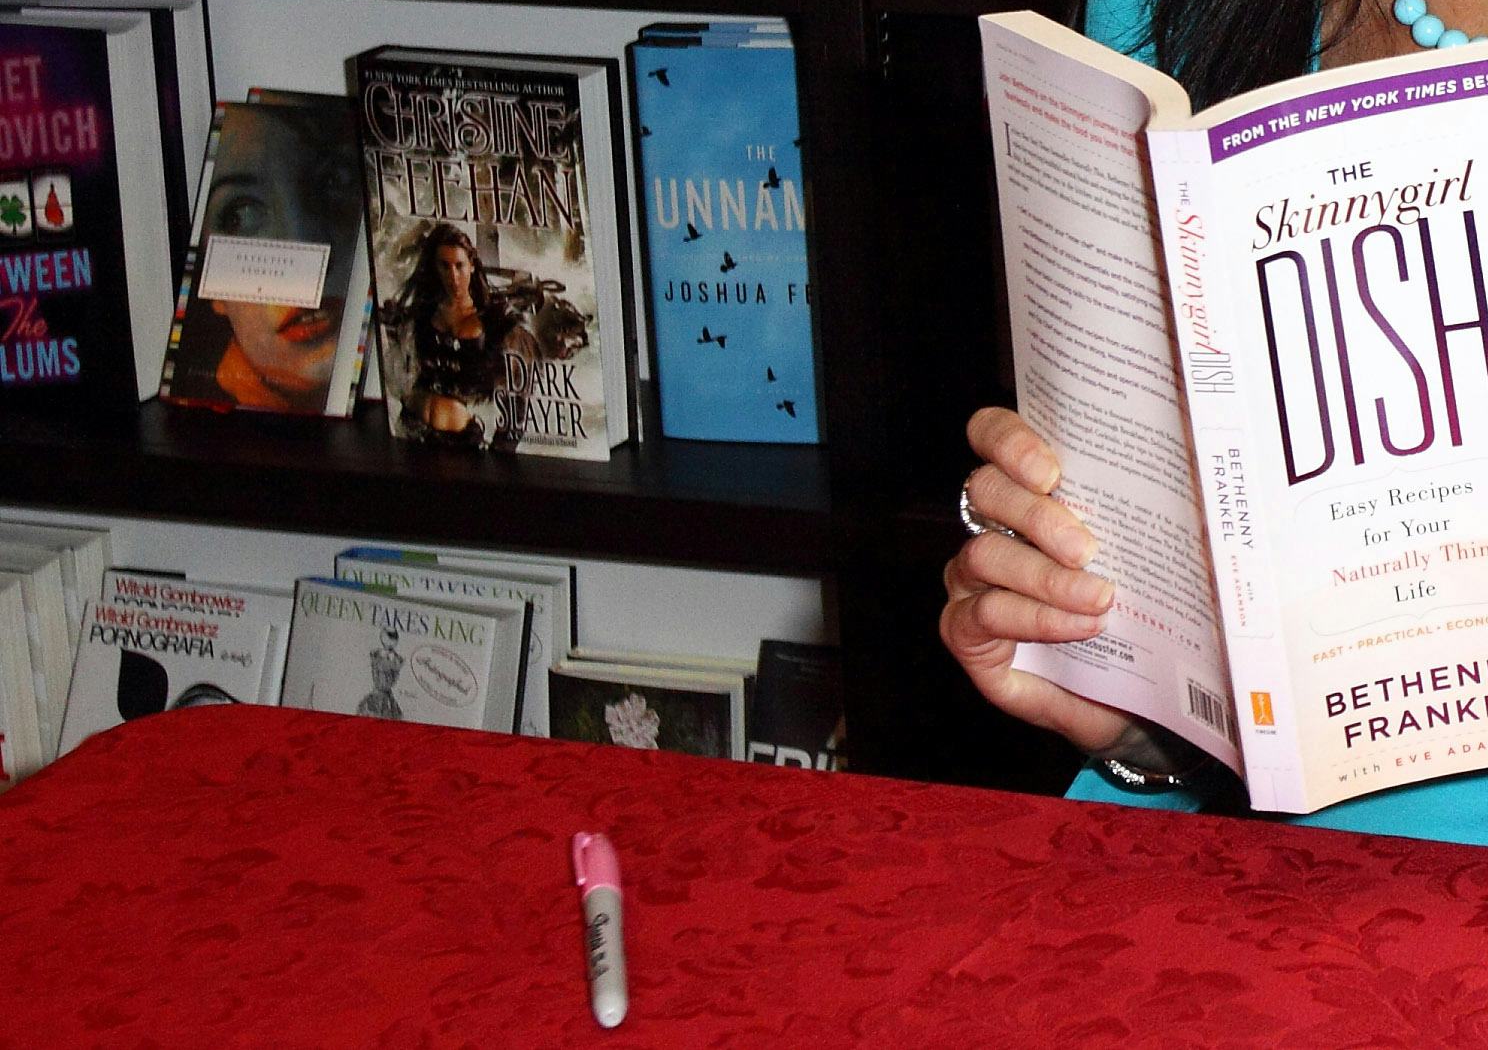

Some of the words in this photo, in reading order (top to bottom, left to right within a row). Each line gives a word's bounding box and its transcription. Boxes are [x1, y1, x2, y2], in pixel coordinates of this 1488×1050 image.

[522, 84, 565, 97] AUTHOR
[365, 83, 571, 163] CHRISTINE
[1221, 123, 1265, 152] FROM
[1268, 113, 1301, 139] THE
[1305, 101, 1346, 124] NEW
[1351, 90, 1400, 113] YORK
[1404, 80, 1458, 102] TIMES
[746, 145, 776, 163] THE
[1326, 161, 1374, 186] THE
[364, 146, 575, 233] FEEHAN
[1178, 181, 1190, 206] THE
[1251, 159, 1475, 253] Skinnygirl
[665, 281, 766, 304] JOSHUA
[1176, 208, 1221, 355] Skinnygirl
[505, 352, 581, 401] DARK
[1189, 352, 1236, 393] DISH
[494, 389, 589, 440] SLAYER
[1212, 454, 1235, 542] FRANKEL
[1228, 448, 1254, 550] BETHENNY
[1329, 498, 1379, 522] Easy
[1388, 480, 1474, 507] Recipes
[1362, 528, 1392, 547] for
[1401, 518, 1452, 538] Your
[1333, 548, 1432, 588] Naturally
[116, 576, 157, 600] Witold
[160, 582, 246, 612] Gombrowicz
[1394, 581, 1438, 604] Life
[95, 604, 136, 628] Witold
[137, 612, 219, 638] Gombrowicz
[301, 591, 364, 622] QUEEN
[371, 604, 430, 632] TAKES
[434, 614, 486, 646] KING
[89, 625, 215, 659] PORNOGRAFIA
[1312, 645, 1345, 663] FAST
[1357, 625, 1434, 651] PRACTICAL
[1338, 762, 1382, 783] with
[1395, 751, 1432, 768] EVE
